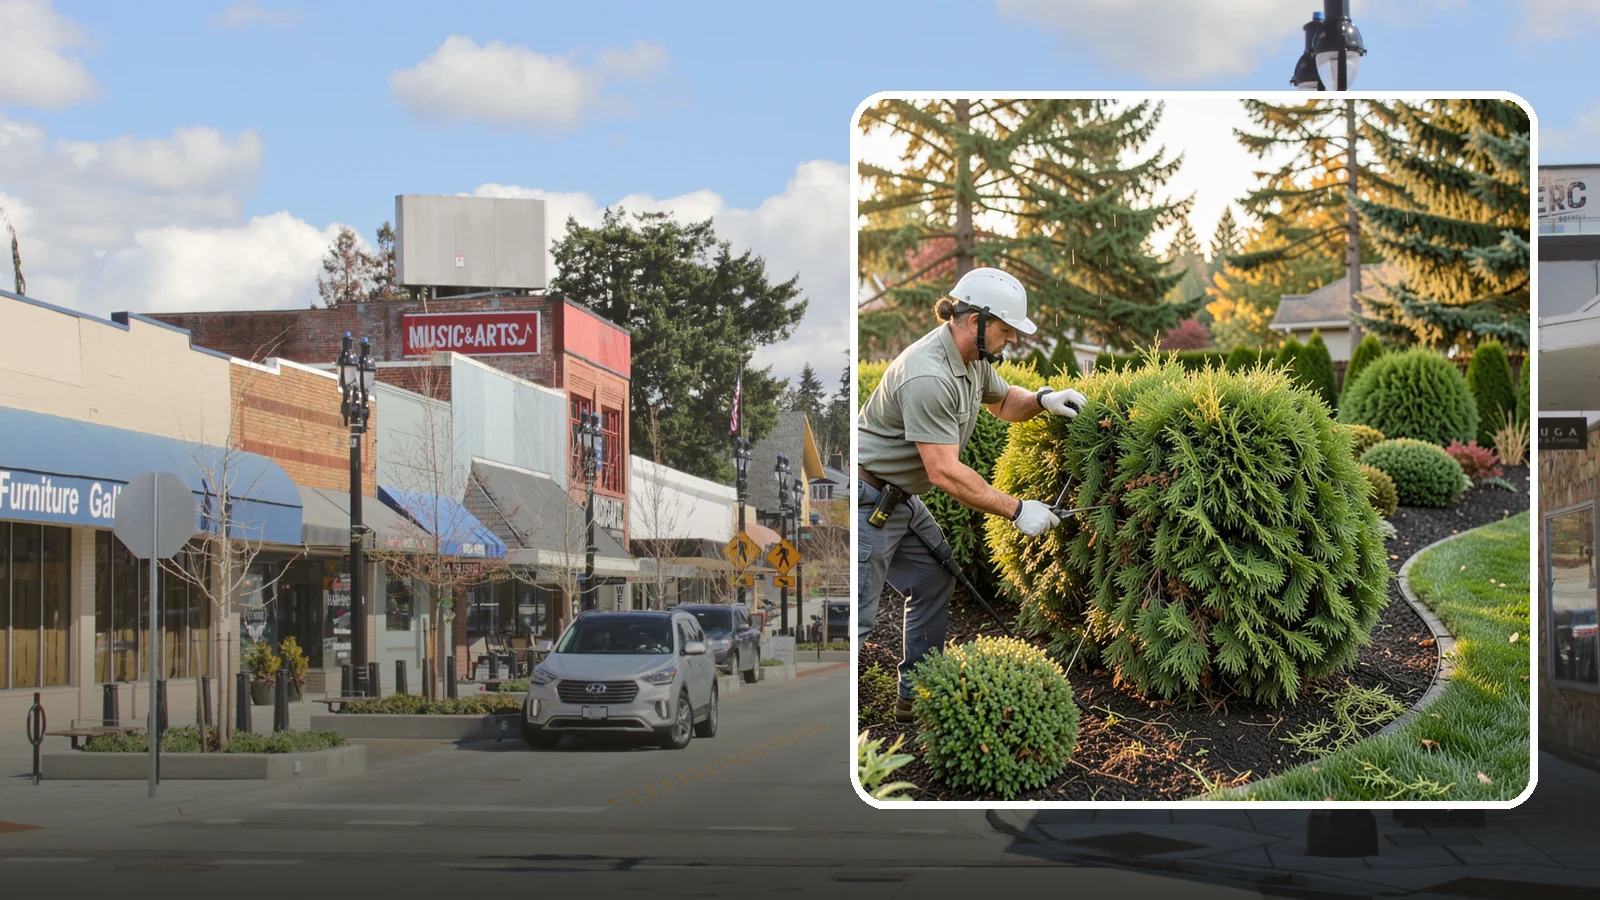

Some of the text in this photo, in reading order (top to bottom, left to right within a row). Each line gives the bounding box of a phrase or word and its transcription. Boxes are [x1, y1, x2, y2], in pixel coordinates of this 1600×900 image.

[0, 471, 121, 519] Furniture Gal
[453, 563, 479, 574] SUSHI
